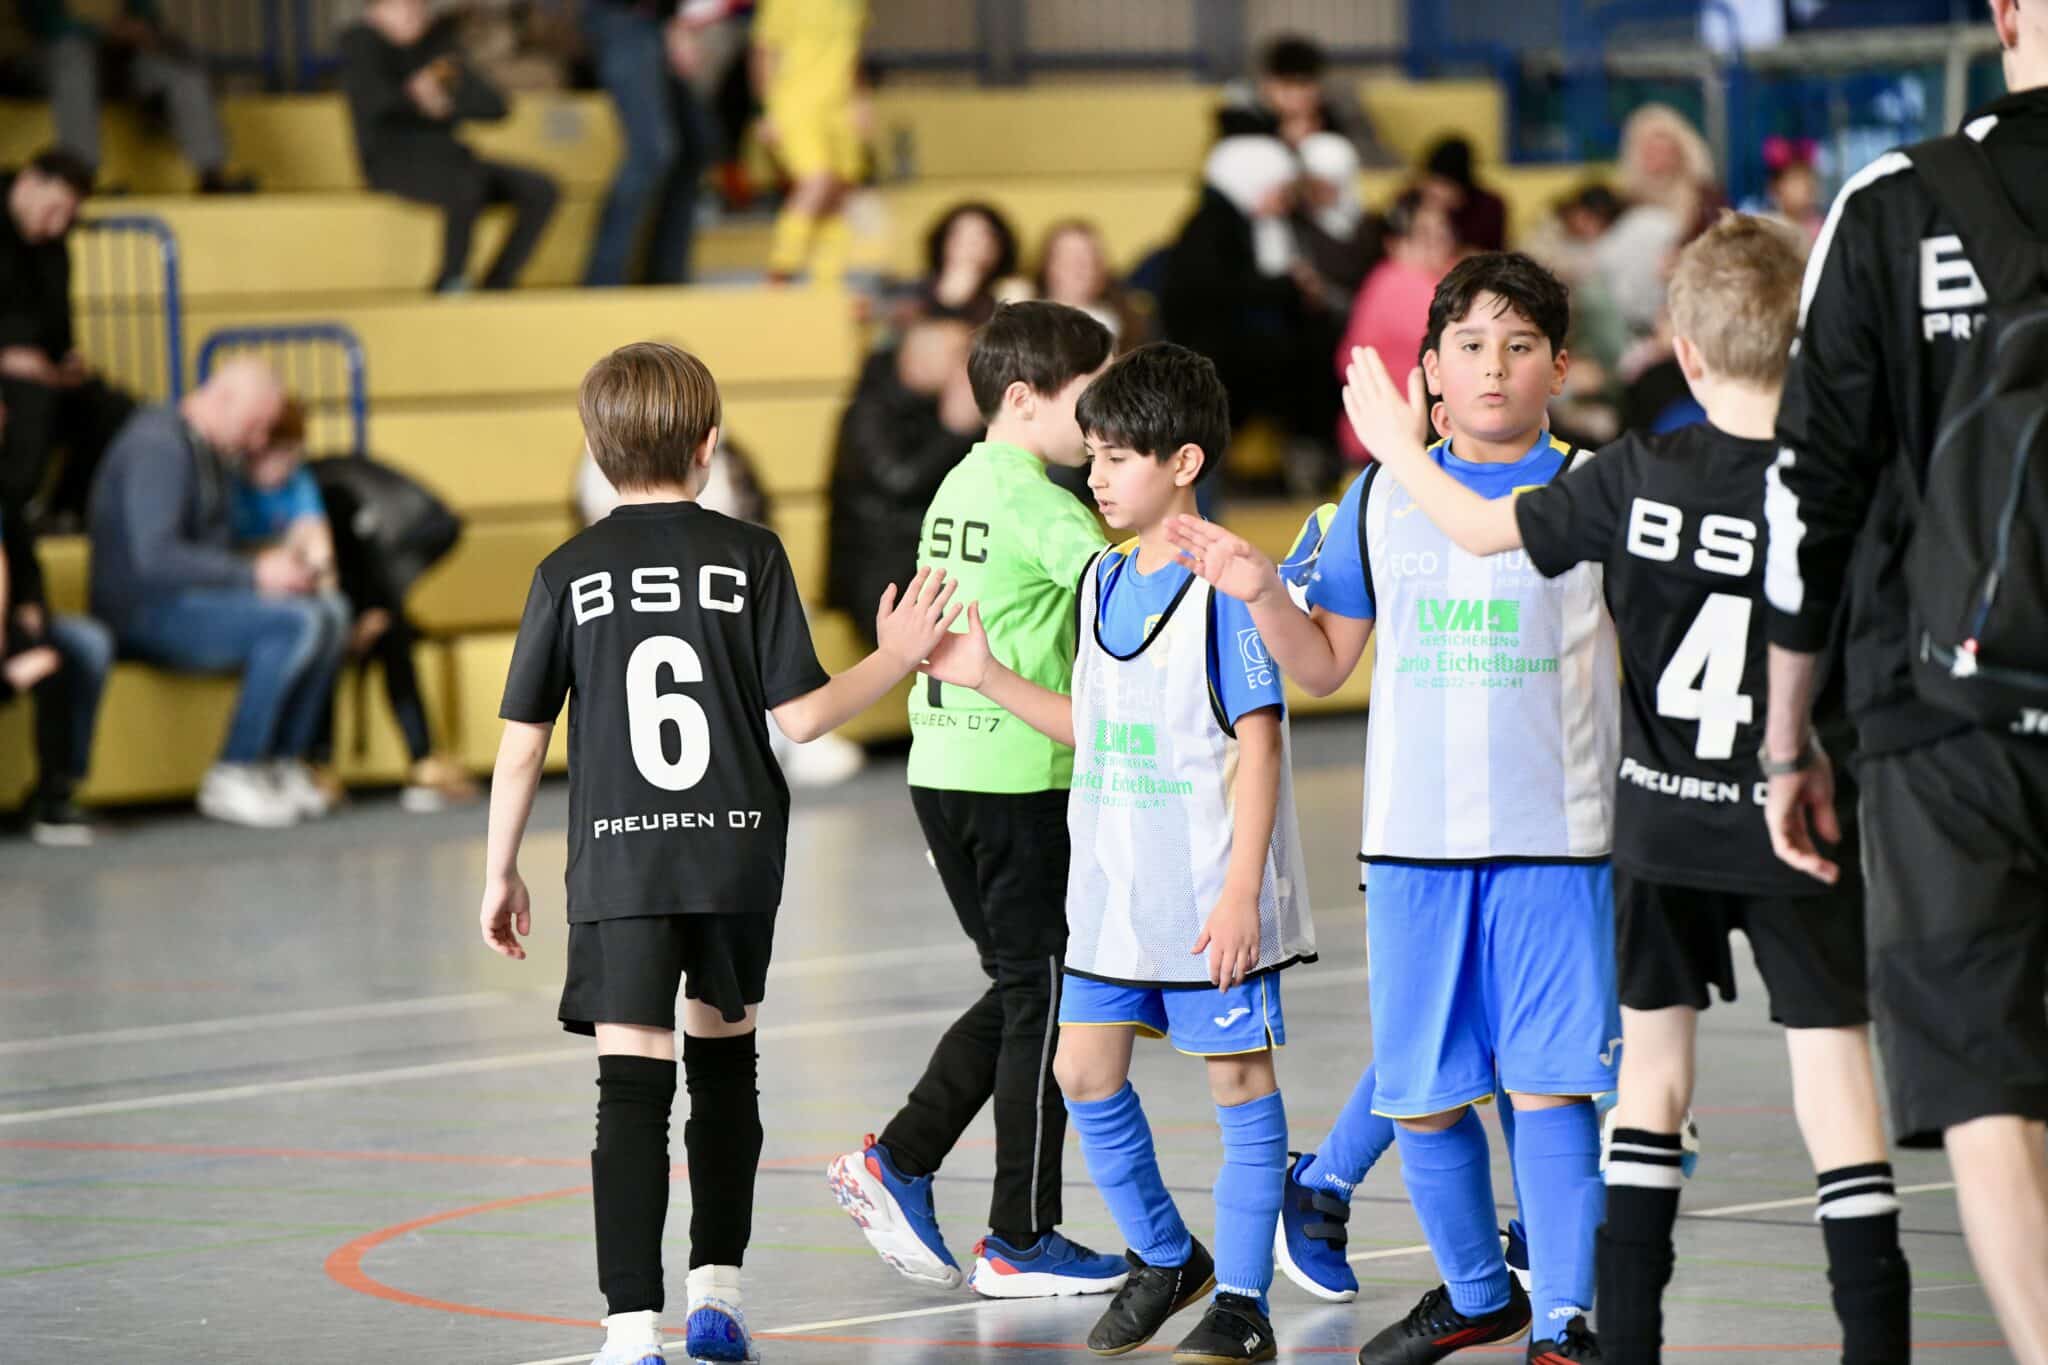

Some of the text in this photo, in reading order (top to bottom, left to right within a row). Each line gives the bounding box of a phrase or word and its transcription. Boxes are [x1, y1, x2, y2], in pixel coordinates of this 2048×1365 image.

[570, 565, 747, 626] BSC
[1416, 599, 1485, 632] LVM
[1656, 592, 1753, 760] 4
[626, 635, 711, 791] 6
[728, 810, 762, 830] 07
